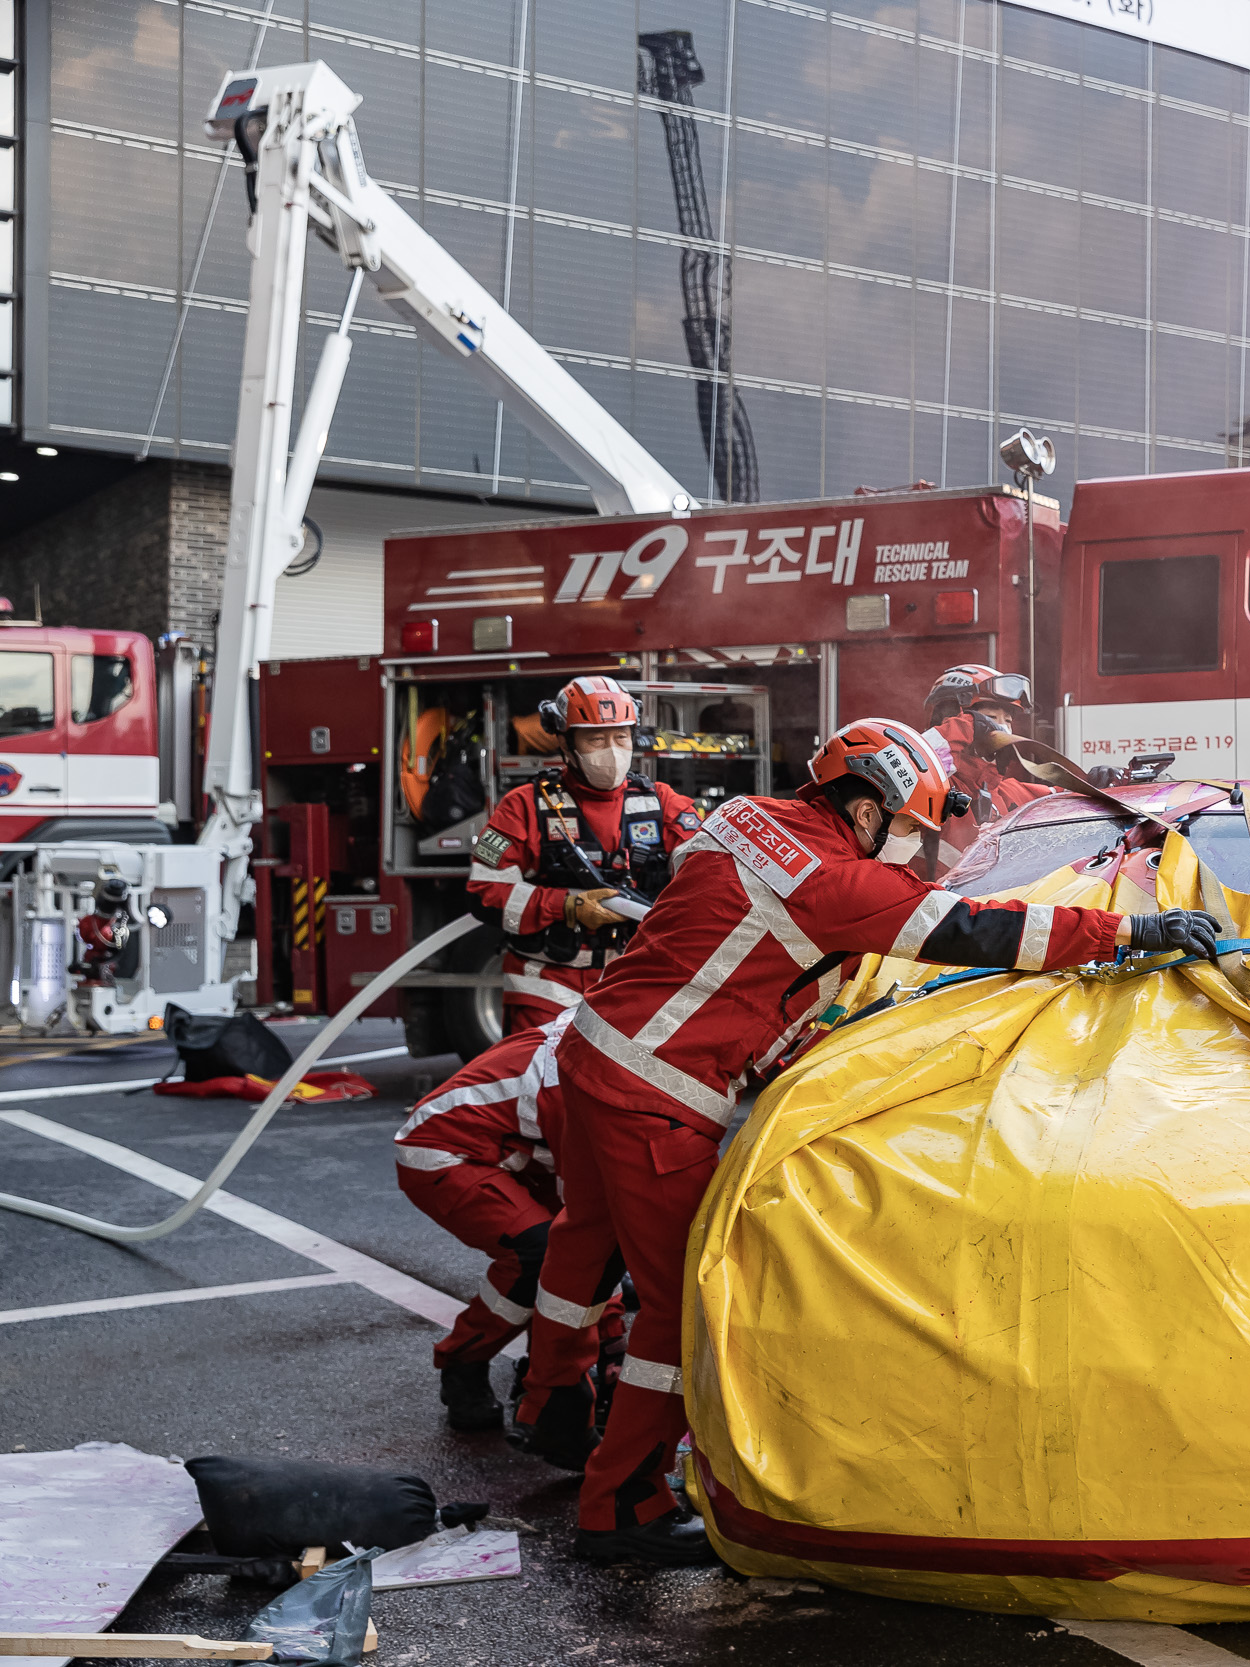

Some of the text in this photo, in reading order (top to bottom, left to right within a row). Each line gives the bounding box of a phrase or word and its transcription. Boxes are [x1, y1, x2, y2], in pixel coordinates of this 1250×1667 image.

[553, 518, 864, 604] 119 구조대
[875, 541, 950, 563] TECHNICAL
[874, 560, 970, 583] RESCUE TEAM
[1204, 736, 1234, 749] 119
[883, 749, 914, 789] 서울광진
[482, 830, 512, 852] FIRE
[714, 821, 769, 870] 서울소방
